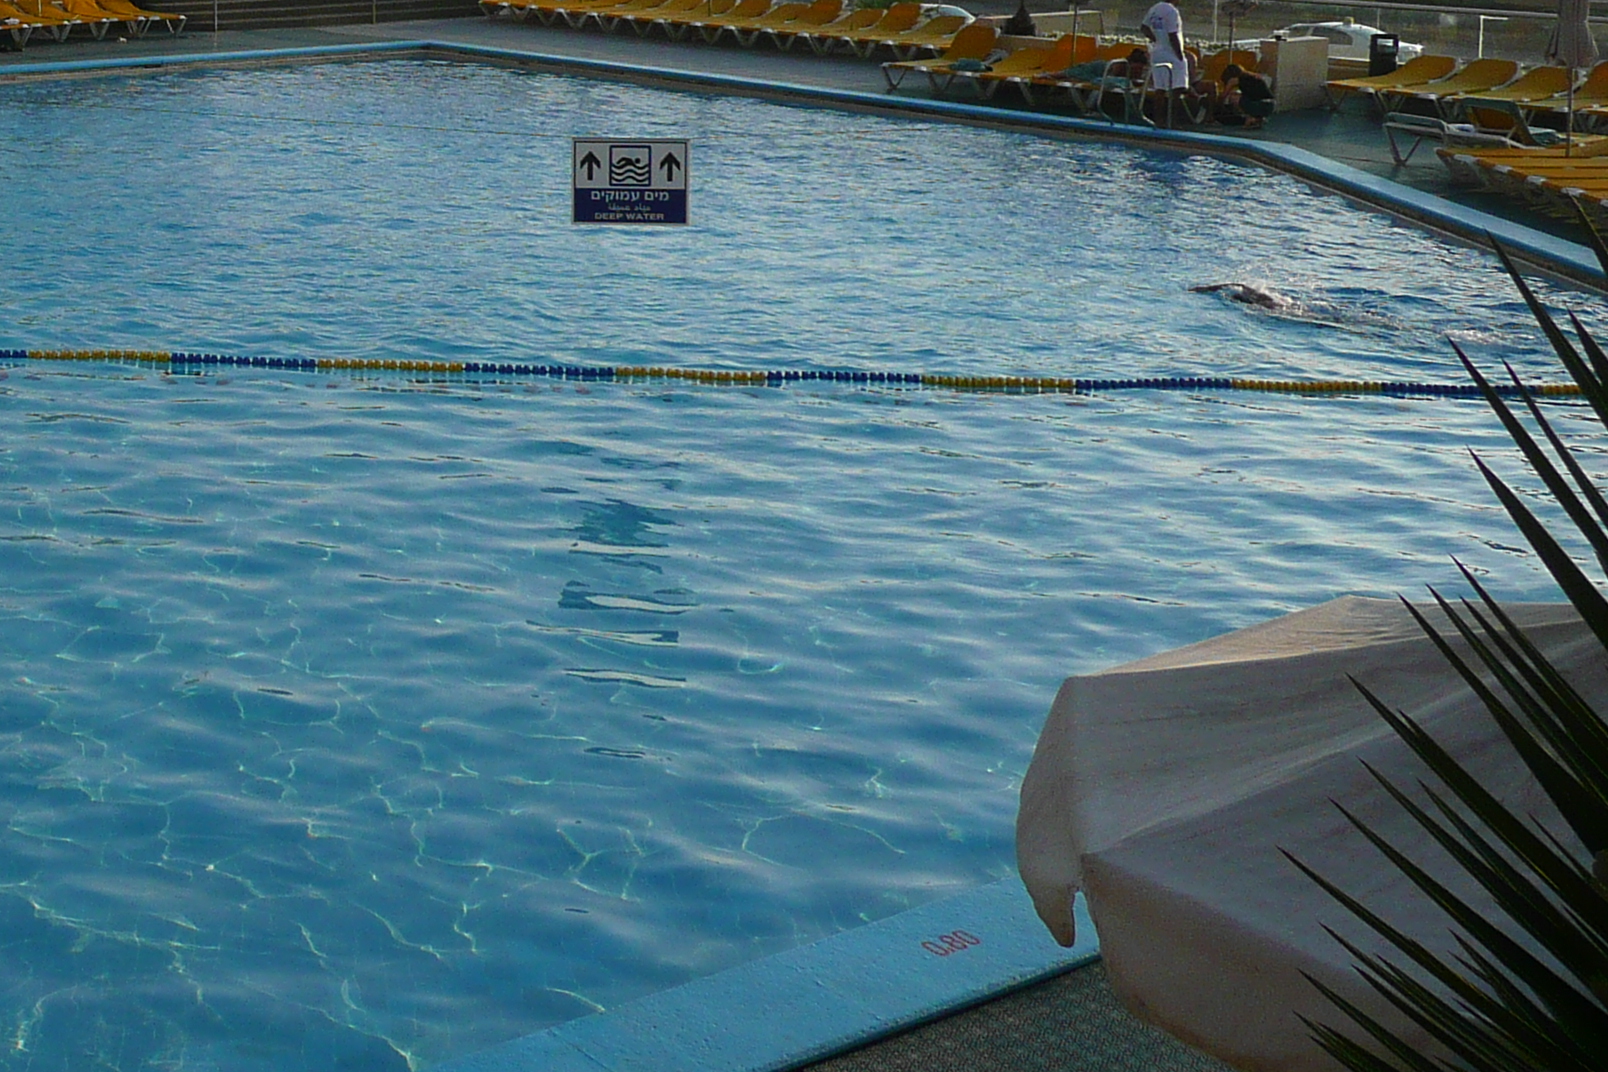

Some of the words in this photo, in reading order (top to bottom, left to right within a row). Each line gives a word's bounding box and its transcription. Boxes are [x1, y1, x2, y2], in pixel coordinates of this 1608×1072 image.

[591, 191, 640, 202] עמוקים
[644, 191, 669, 201] מים
[594, 212, 623, 220] DEEP
